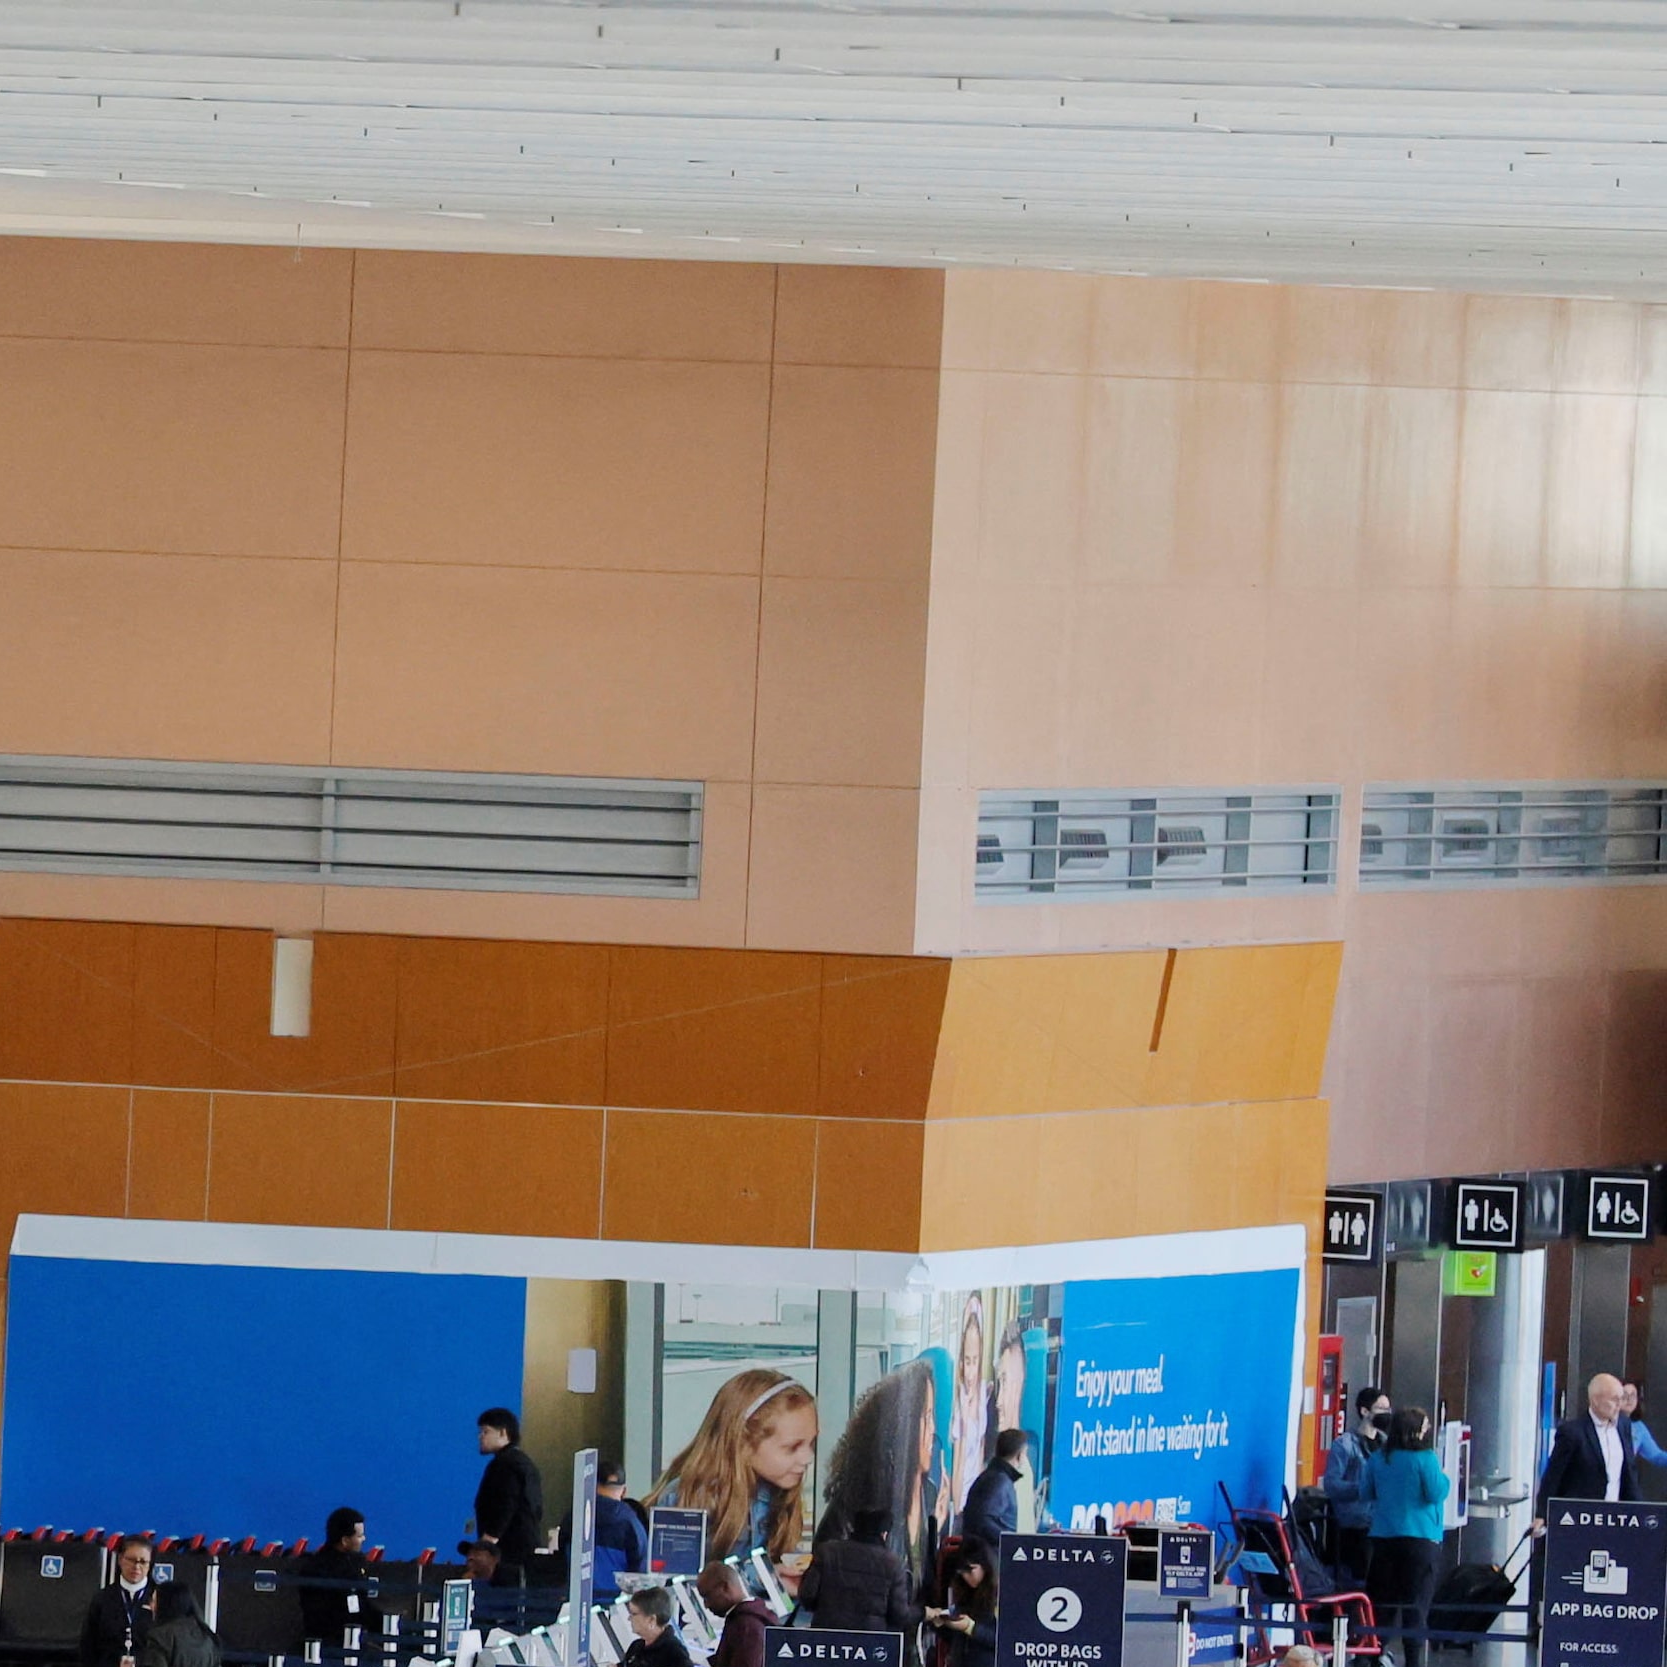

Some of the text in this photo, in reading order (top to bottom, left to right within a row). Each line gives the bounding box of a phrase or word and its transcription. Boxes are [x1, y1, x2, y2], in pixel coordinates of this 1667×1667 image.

[1075, 1353, 1164, 1408] Enjoy your meal.
[1072, 1420, 1103, 1458] Don't
[1103, 1415, 1135, 1455] stand
[1135, 1417, 1147, 1453] in
[1147, 1414, 1166, 1452] line
[1167, 1414, 1205, 1460] waiting
[1579, 1512, 1640, 1528] DELTA
[1032, 1548, 1095, 1563] DELTA
[1050, 1596, 1068, 1623] 2
[1550, 1602, 1659, 1620] APP BAG DROP
[800, 1644, 867, 1660] DELTA
[1014, 1642, 1102, 1660] DROP BAGS
[1560, 1641, 1579, 1652] FOR
